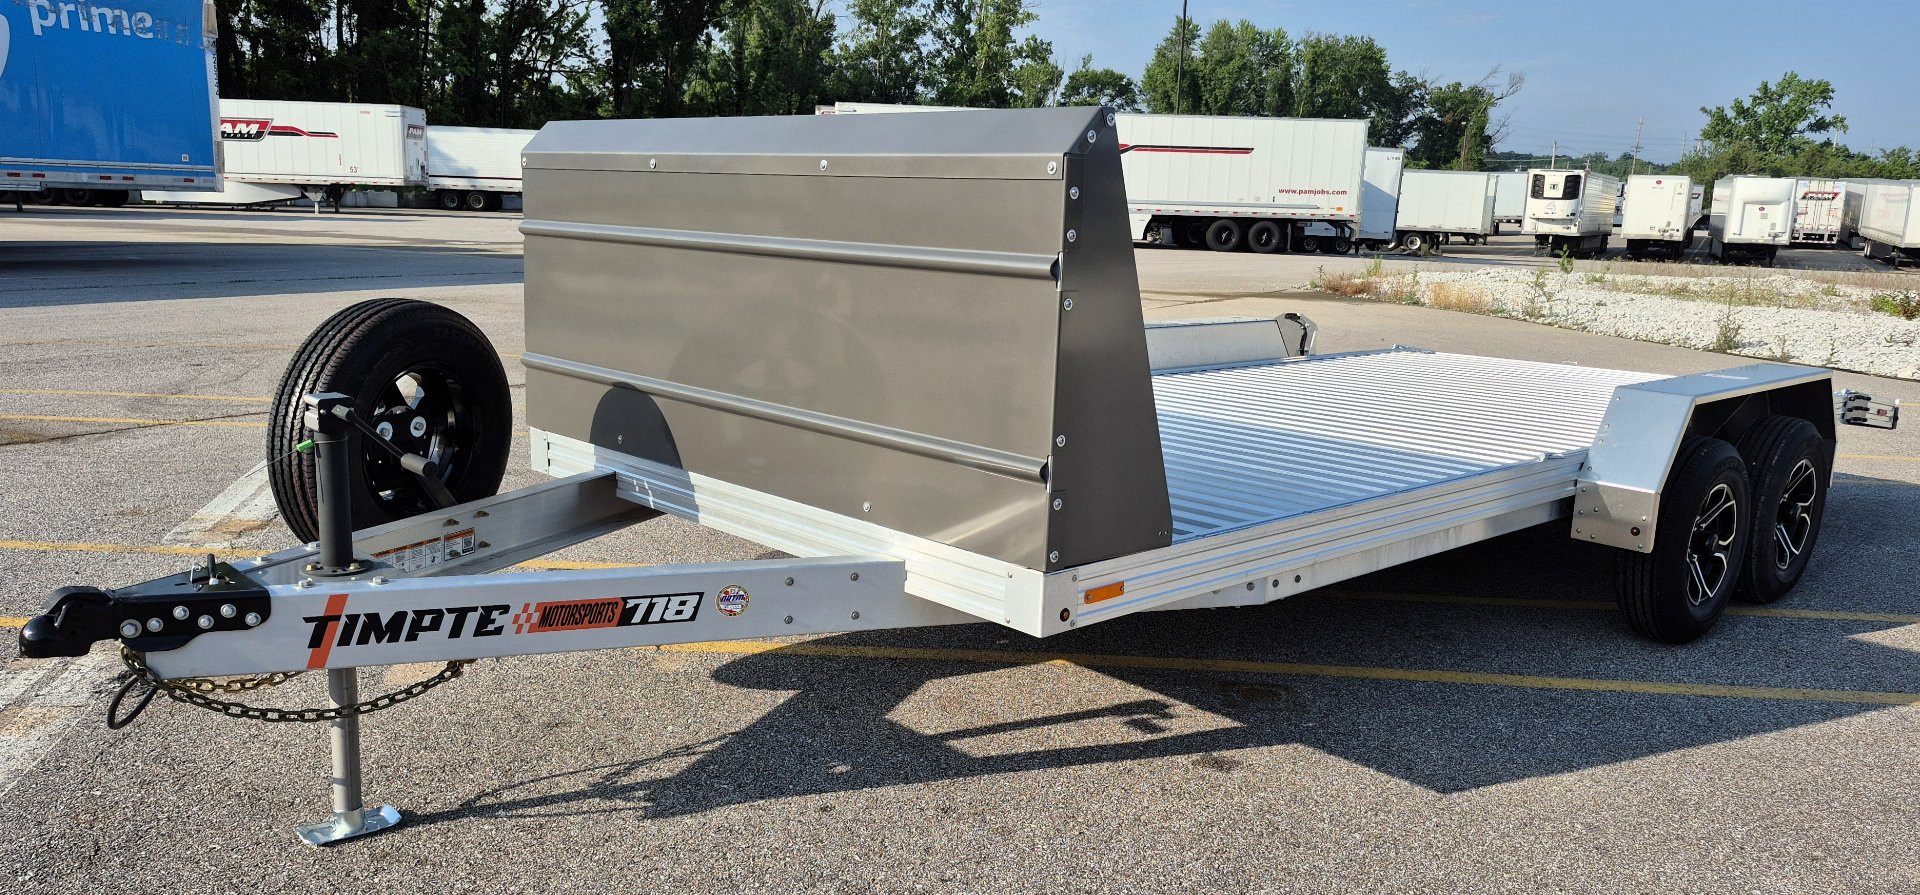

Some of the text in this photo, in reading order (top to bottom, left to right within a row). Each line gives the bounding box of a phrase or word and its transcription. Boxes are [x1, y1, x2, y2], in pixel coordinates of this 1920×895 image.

[28, 0, 154, 39] prime
[220, 122, 260, 134] AM
[408, 127, 423, 136] PAM
[1278, 188, 1347, 196] www.pamjobs.com
[302, 602, 512, 651] TIMPTE
[539, 601, 618, 629] MOTORSPORTS
[630, 595, 696, 624] 718
